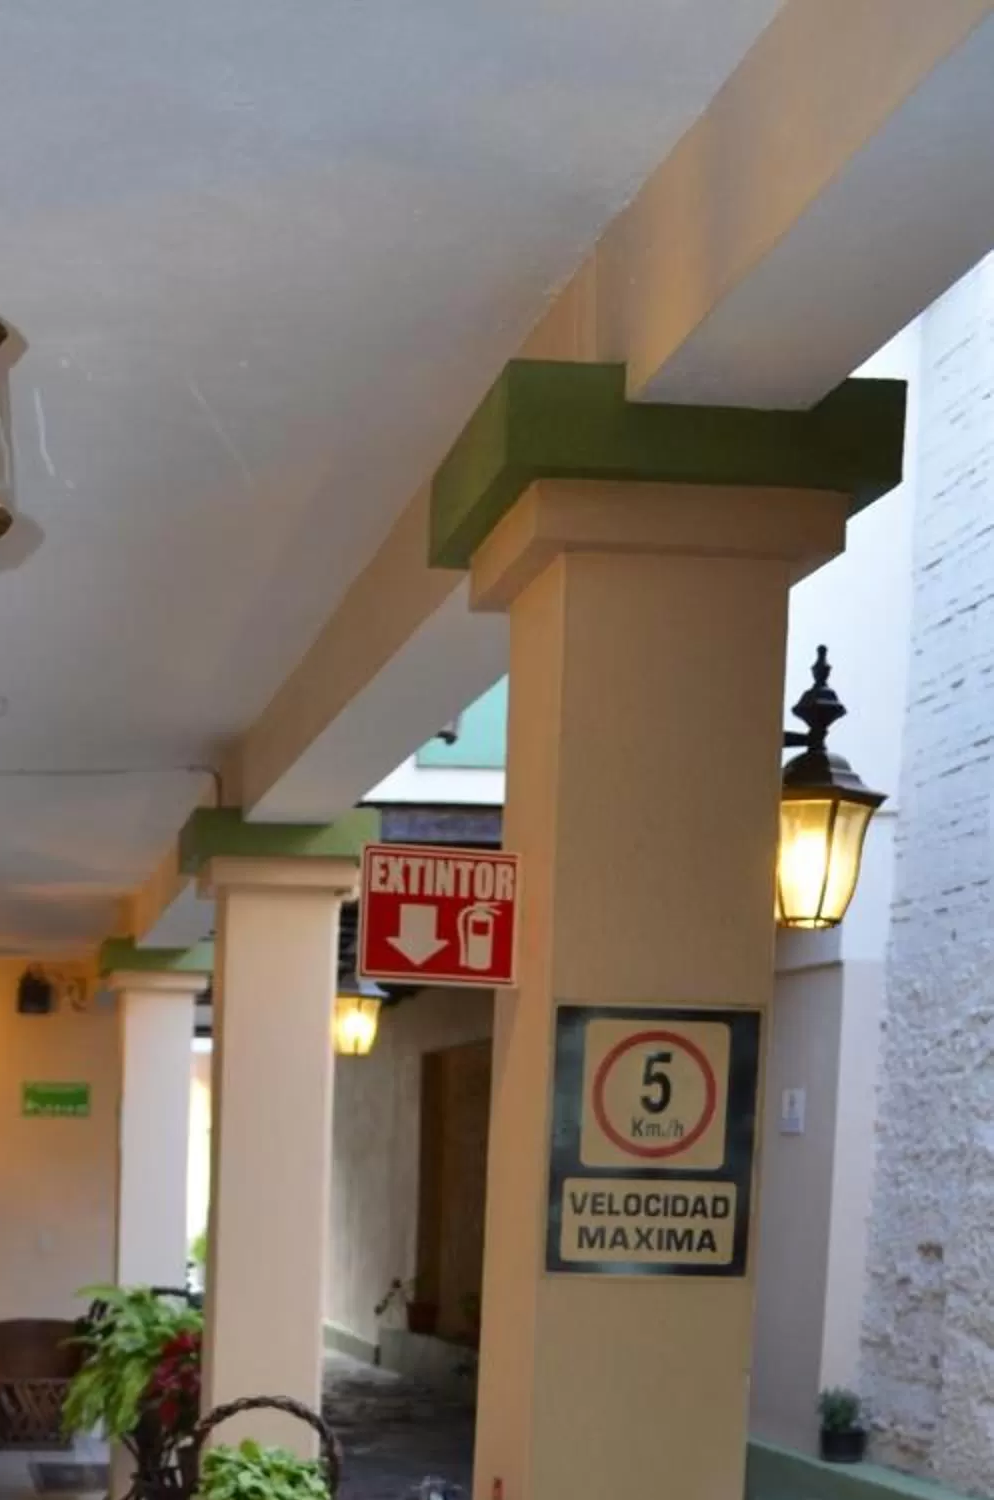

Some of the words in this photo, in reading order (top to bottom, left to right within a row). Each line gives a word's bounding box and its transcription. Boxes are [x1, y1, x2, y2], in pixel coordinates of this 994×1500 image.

[369, 855, 514, 900] EXTINTOR
[641, 1052, 672, 1114] 5
[571, 1192, 731, 1219] VELOCIDAD
[577, 1227, 717, 1253] MAXIMA
